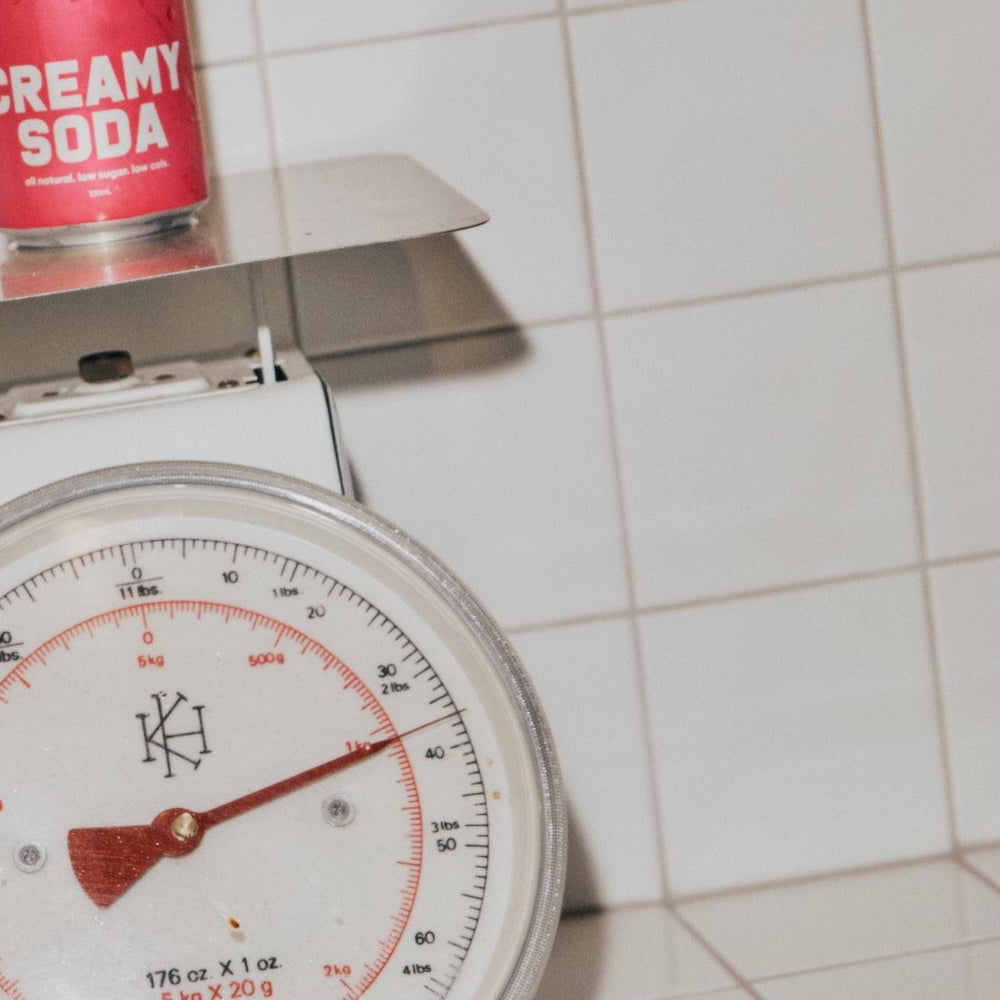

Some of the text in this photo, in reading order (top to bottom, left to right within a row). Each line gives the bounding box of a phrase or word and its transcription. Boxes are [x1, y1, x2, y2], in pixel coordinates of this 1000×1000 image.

[17, 102, 169, 167] SODA
[25, 176, 36, 187] all
[77, 172, 97, 182] low
[131, 164, 149, 173] low
[132, 567, 142, 580] 0
[222, 570, 239, 584] 10
[307, 605, 326, 619] 20
[142, 631, 154, 645] 0
[377, 663, 397, 678] 30
[425, 745, 445, 759] 40
[437, 837, 457, 852] 50
[415, 930, 436, 945] 60
[146, 968, 182, 989] 176
[241, 956, 250, 973] 1
[256, 956, 283, 971] oz.
[229, 979, 256, 999] 20
[260, 980, 274, 998] g
